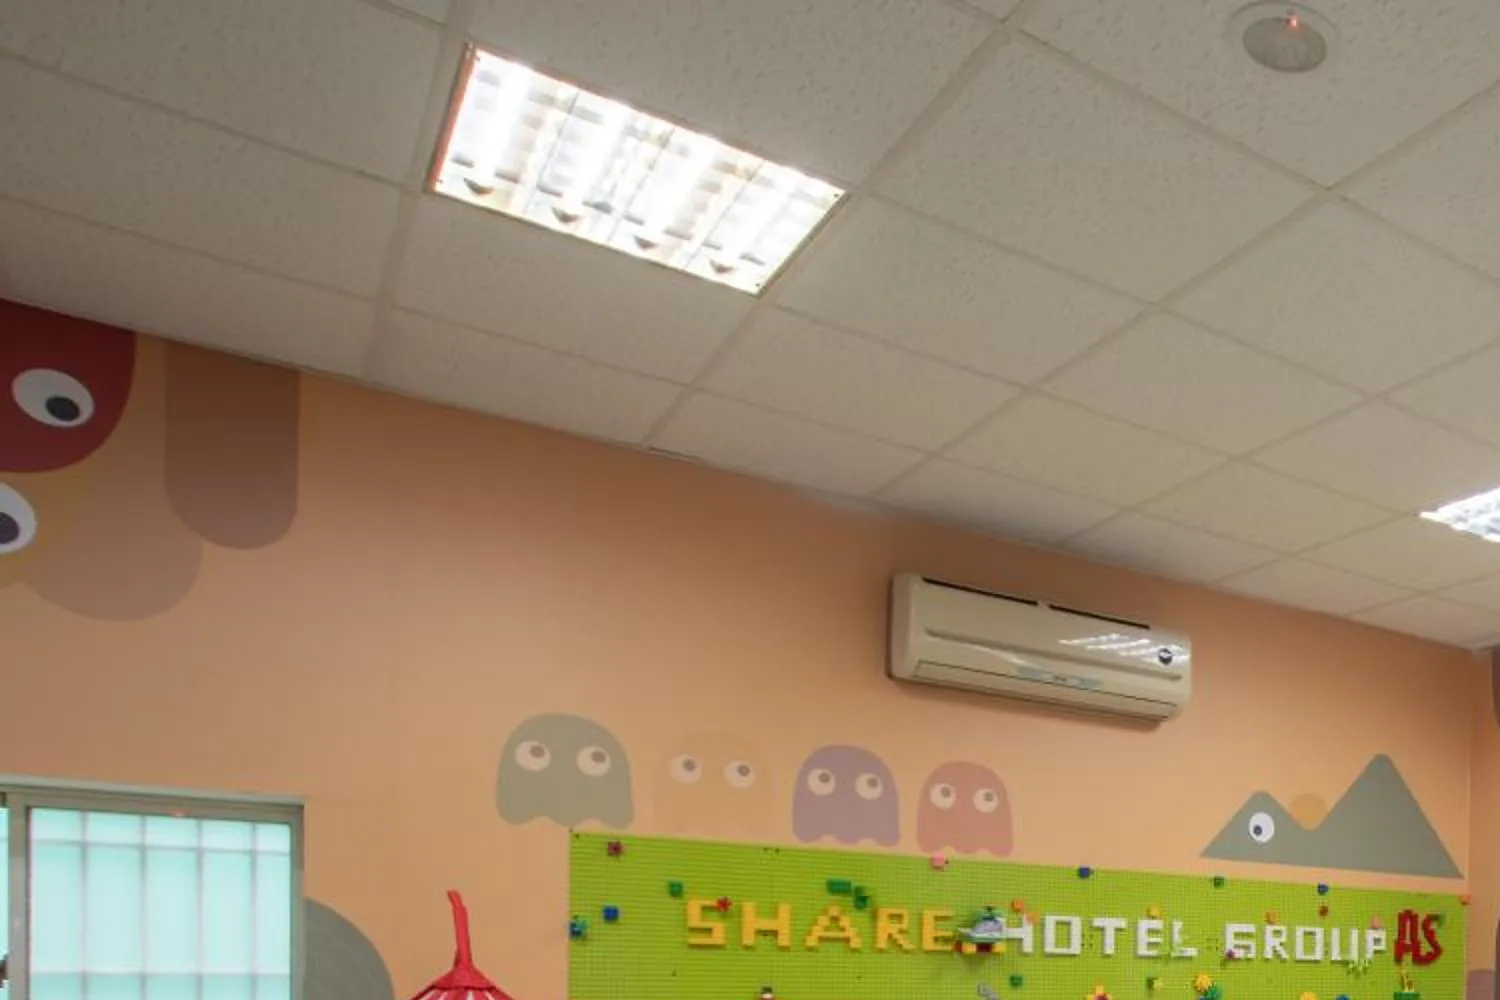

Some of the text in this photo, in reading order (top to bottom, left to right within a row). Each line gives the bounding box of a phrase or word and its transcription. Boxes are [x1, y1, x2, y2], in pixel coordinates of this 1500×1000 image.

[685, 898, 1444, 966] SHARE HOTEL GROUP AS
